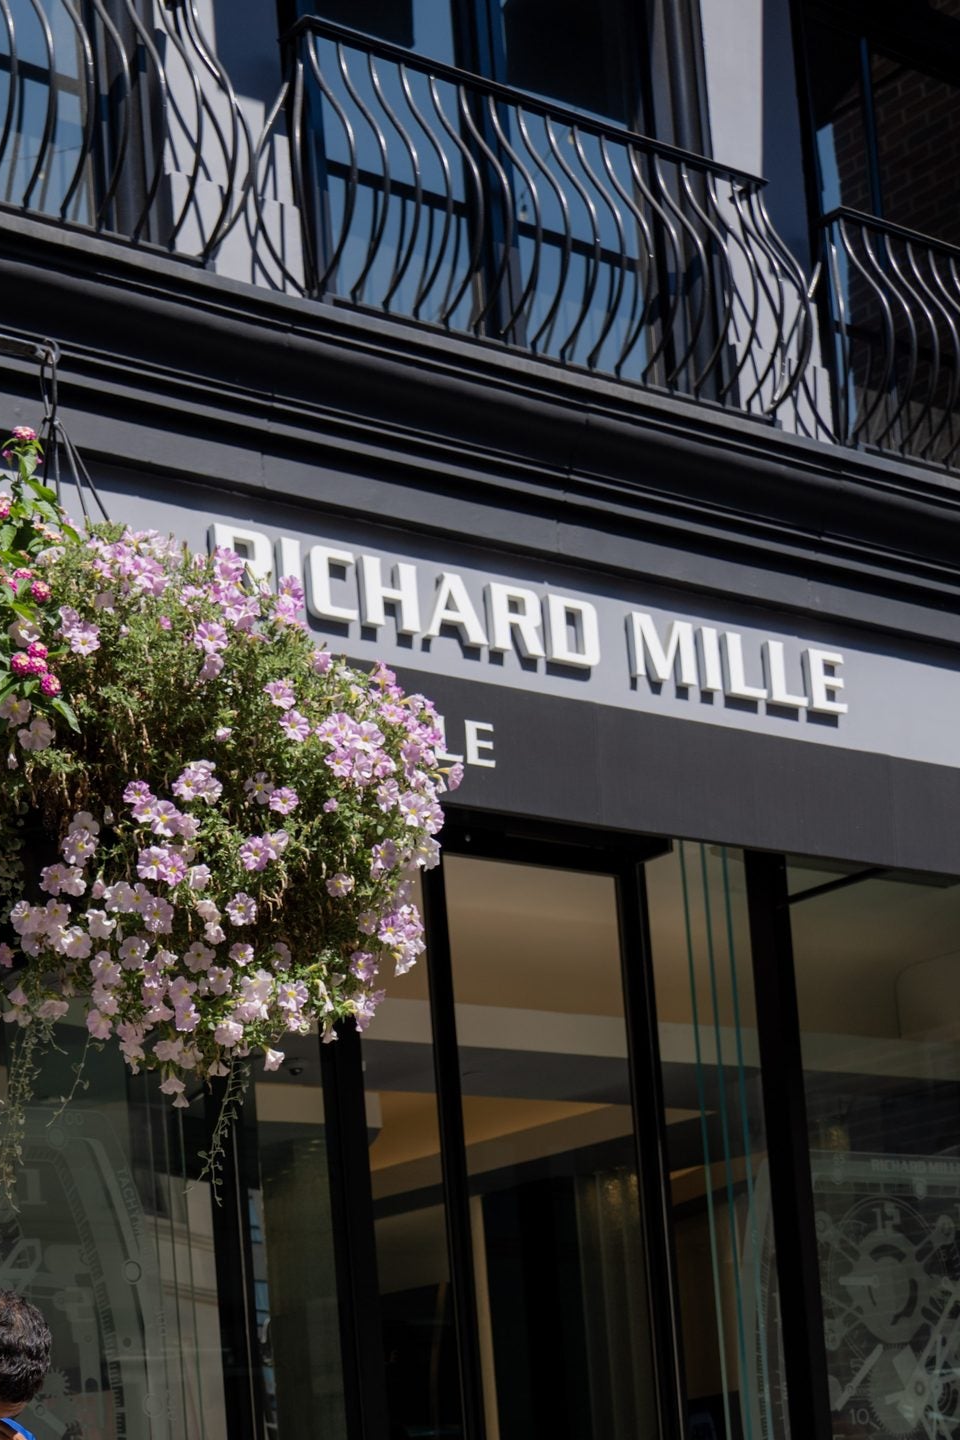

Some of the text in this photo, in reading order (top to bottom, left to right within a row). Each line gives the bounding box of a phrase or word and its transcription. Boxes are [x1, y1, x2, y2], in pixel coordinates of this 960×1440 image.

[207, 521, 848, 715] RICHARD MILLE
[433, 713, 496, 768] LE
[849, 1407, 870, 1425] 10
